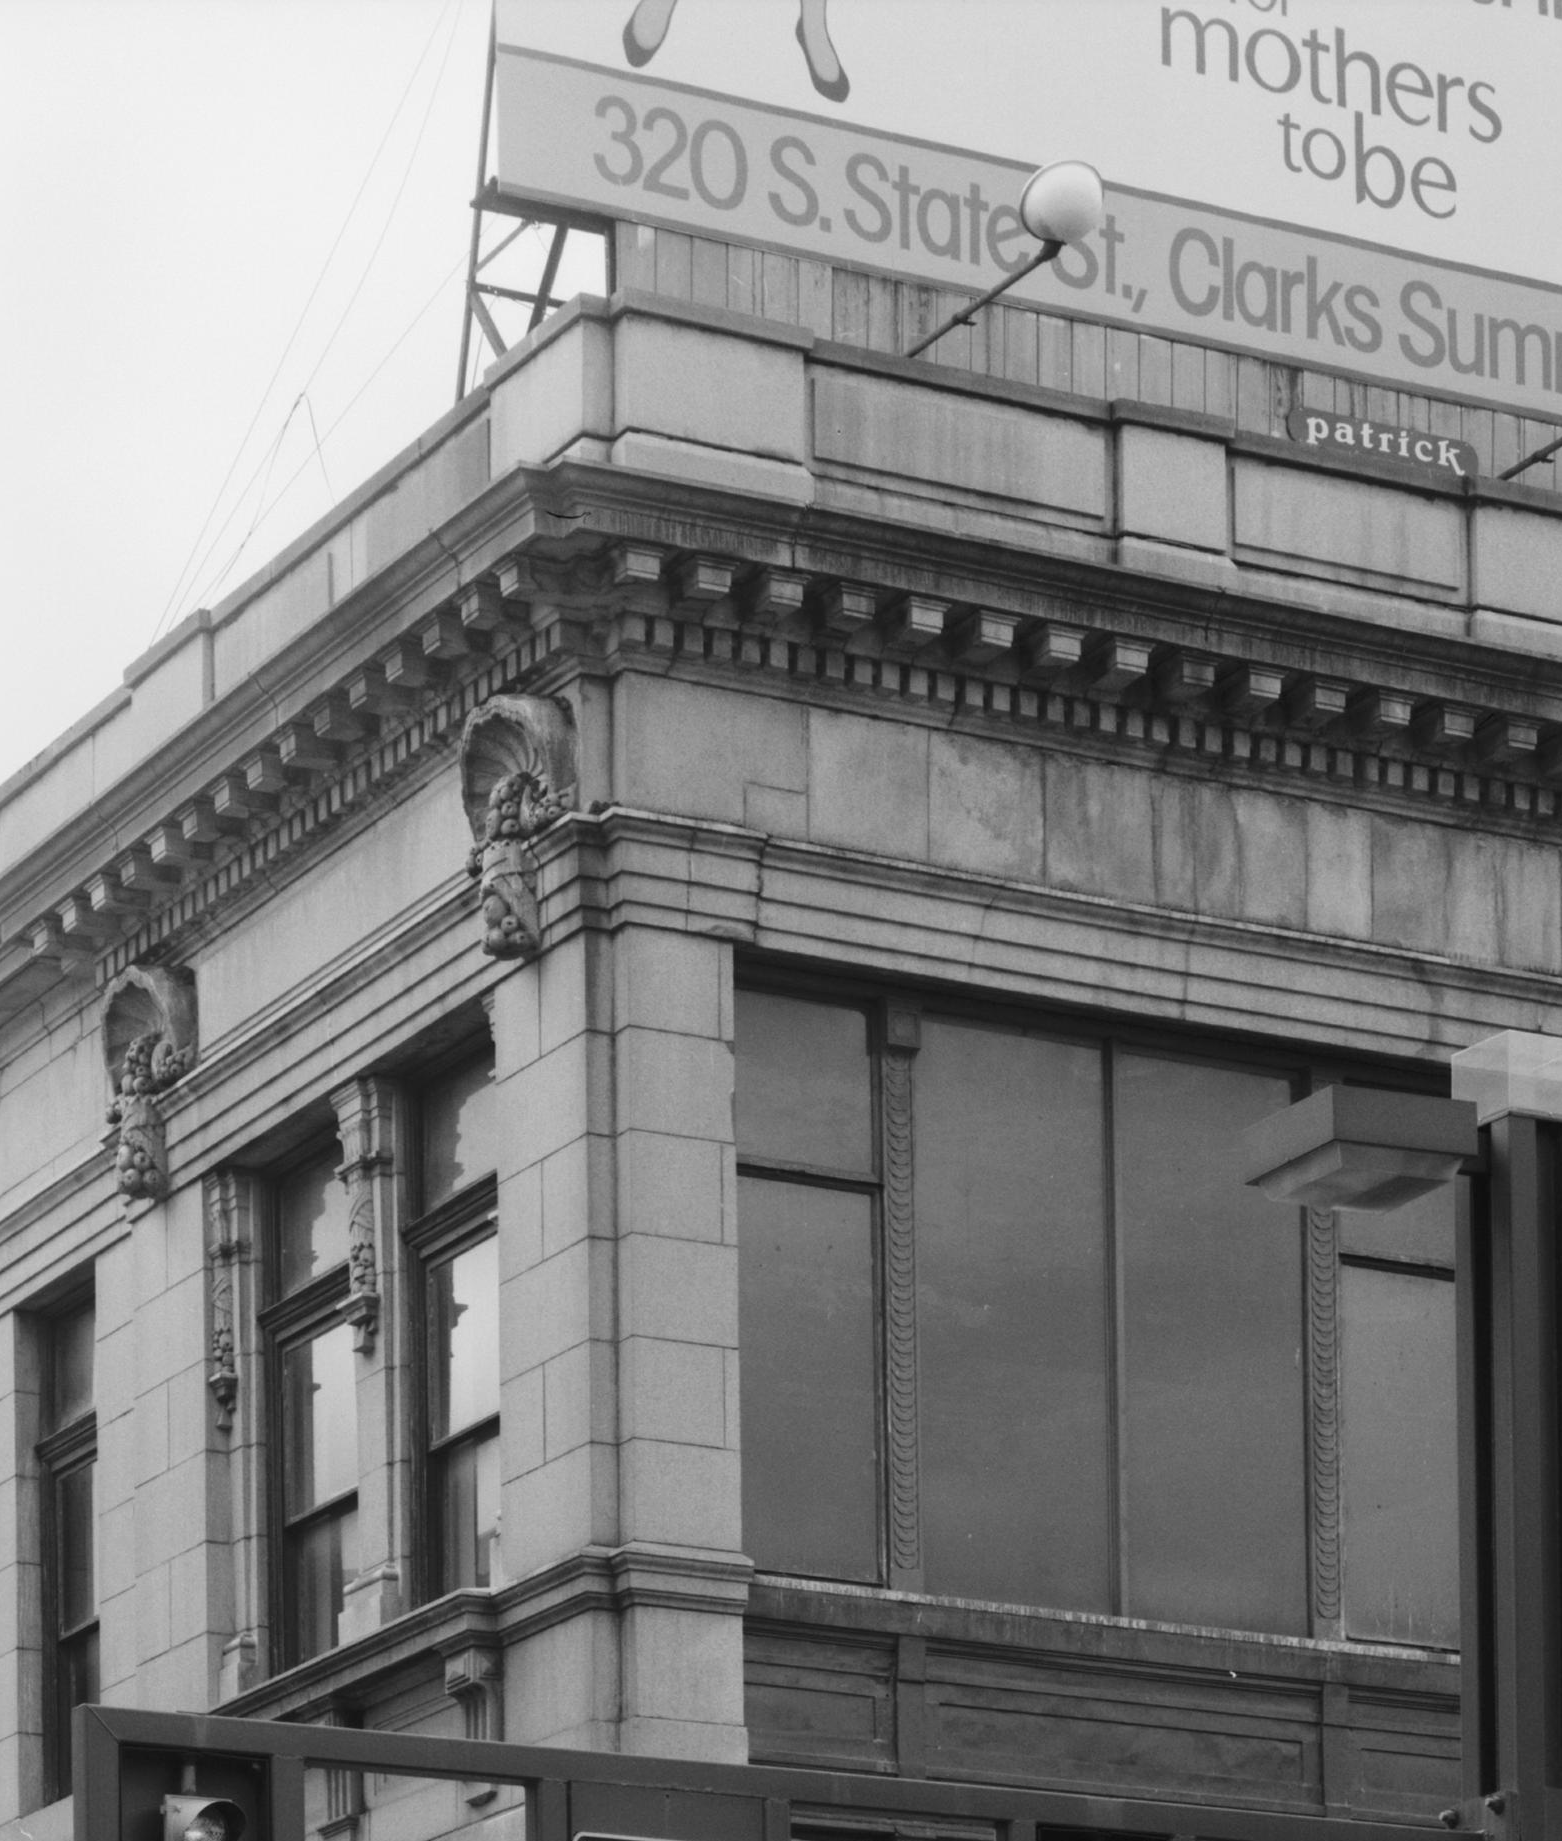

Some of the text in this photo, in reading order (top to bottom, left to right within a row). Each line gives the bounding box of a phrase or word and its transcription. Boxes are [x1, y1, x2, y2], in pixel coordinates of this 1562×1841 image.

[1160, 7, 1503, 143] mothers
[593, 95, 748, 212] 320
[767, 135, 832, 234] S.
[845, 152, 1030, 274] State
[1169, 226, 1383, 354] Clarks
[1306, 417, 1466, 477] patrick
